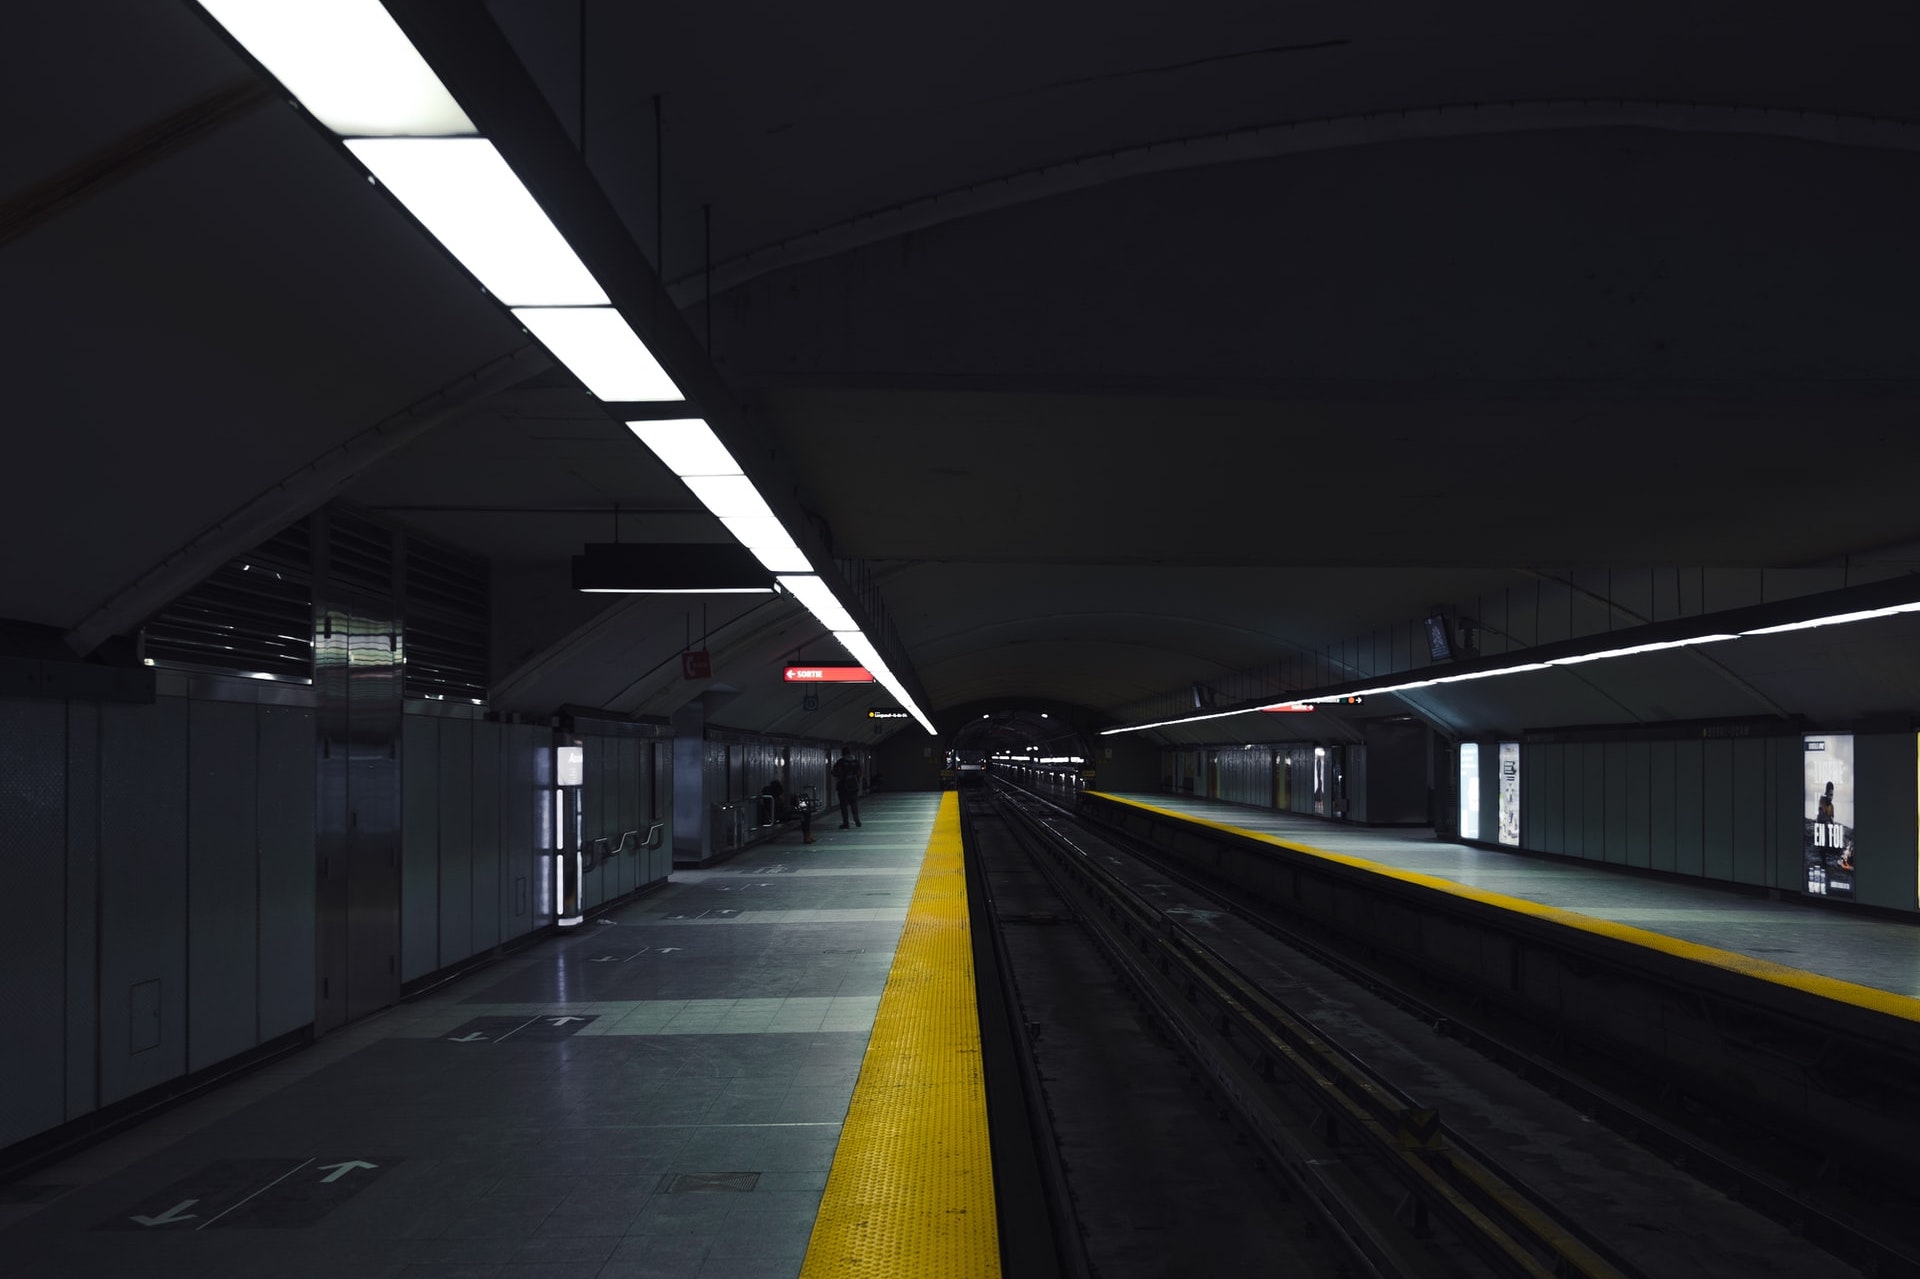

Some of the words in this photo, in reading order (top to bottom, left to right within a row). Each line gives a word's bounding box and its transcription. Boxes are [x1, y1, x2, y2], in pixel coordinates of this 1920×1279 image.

[797, 670, 823, 678] SORTIE
[1814, 823, 1825, 847] EN
[1828, 824, 1843, 849] TOI
